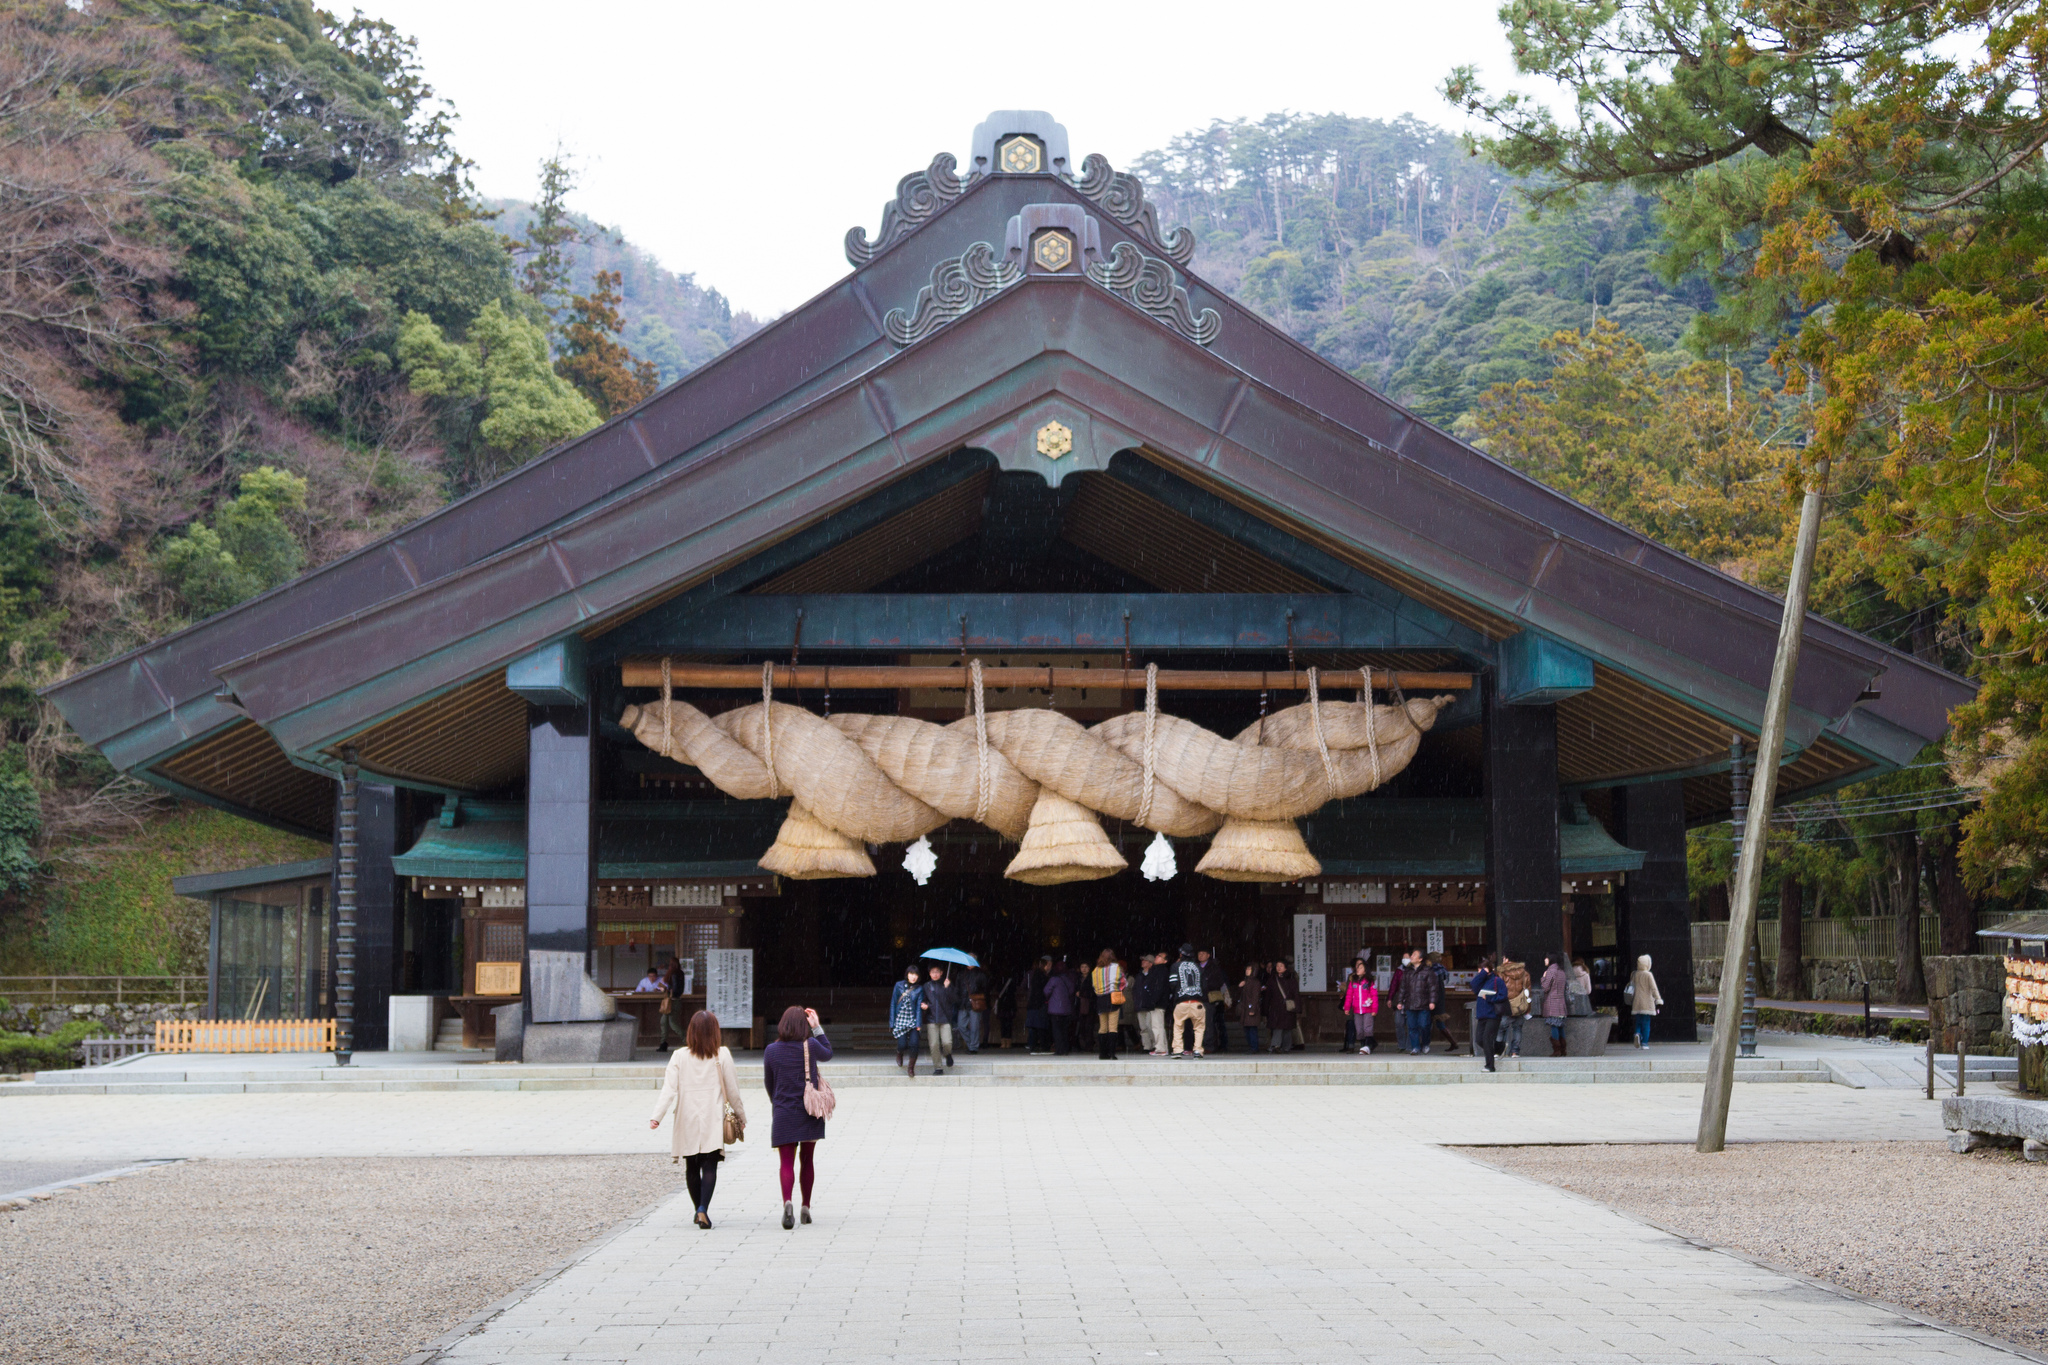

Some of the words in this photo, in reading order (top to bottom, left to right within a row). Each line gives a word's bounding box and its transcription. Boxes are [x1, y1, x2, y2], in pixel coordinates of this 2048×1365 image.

[598, 890, 645, 907] 受付所
[1398, 886, 1478, 904] 御守所
